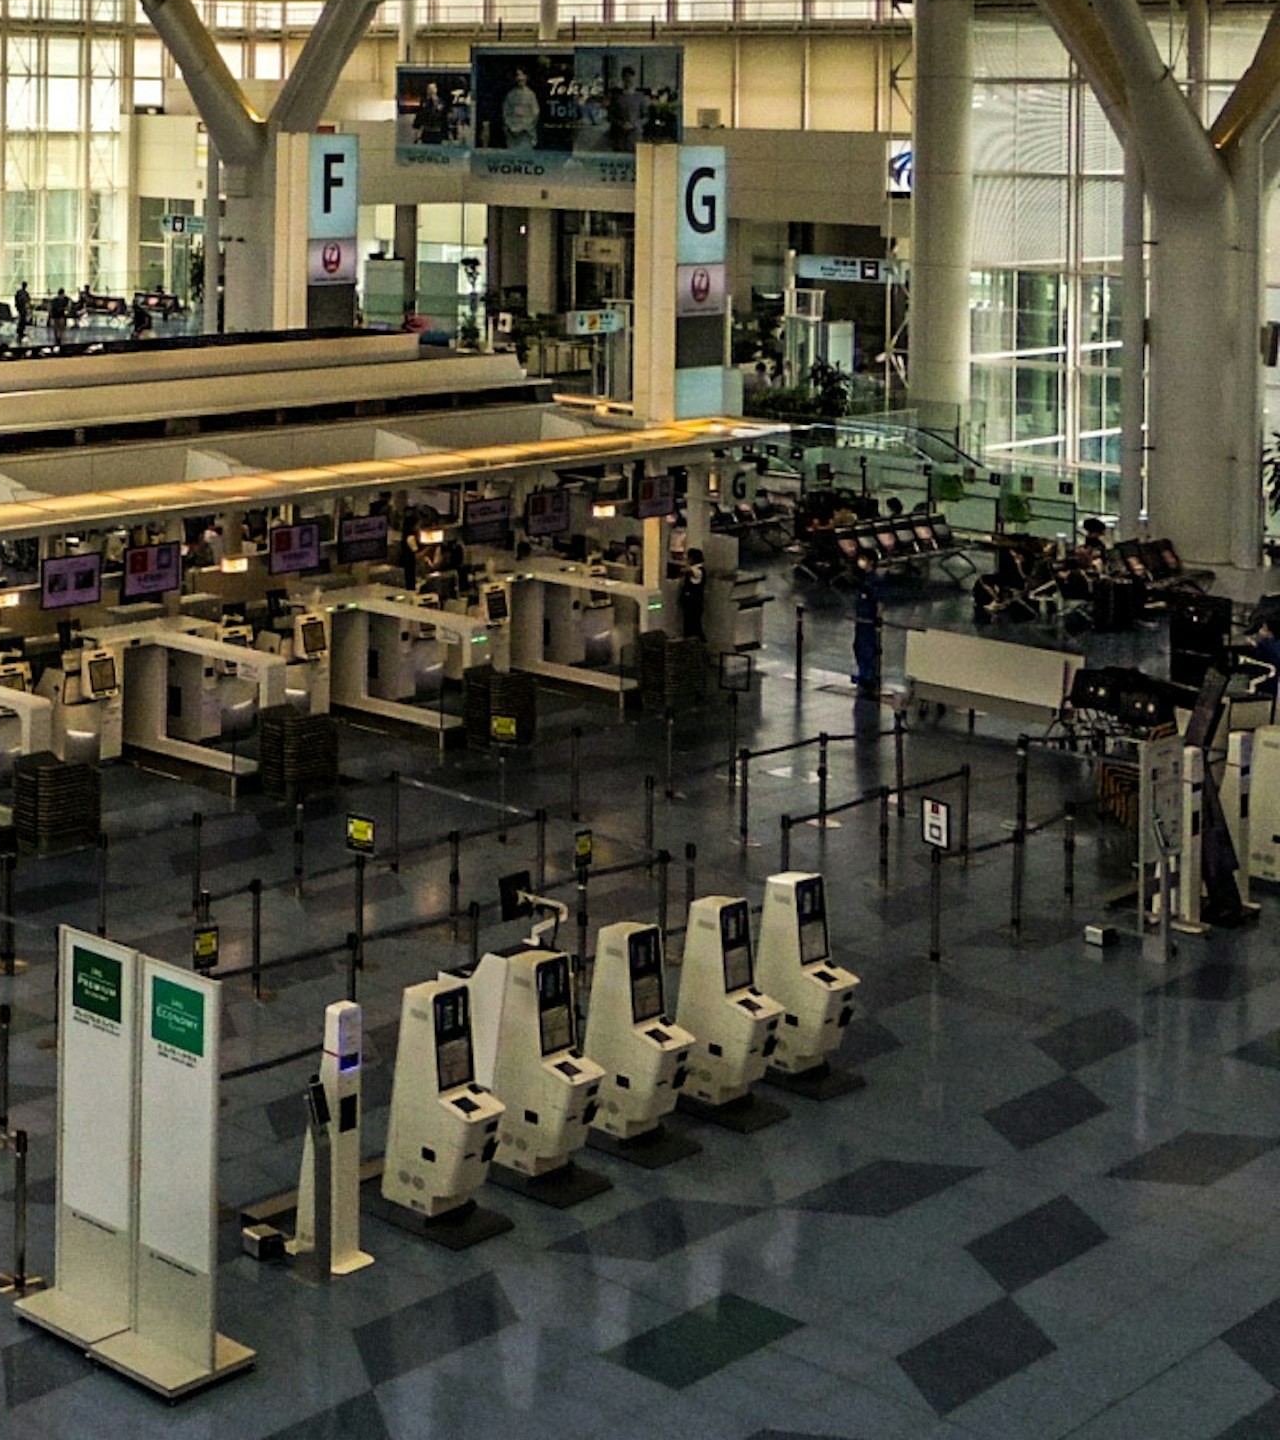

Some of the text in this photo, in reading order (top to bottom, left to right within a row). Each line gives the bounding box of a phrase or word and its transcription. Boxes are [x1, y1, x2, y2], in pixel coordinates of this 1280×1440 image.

[323, 153, 345, 214] F
[487, 164, 545, 176] WORLD
[685, 166, 717, 234] G
[733, 472, 746, 498] G
